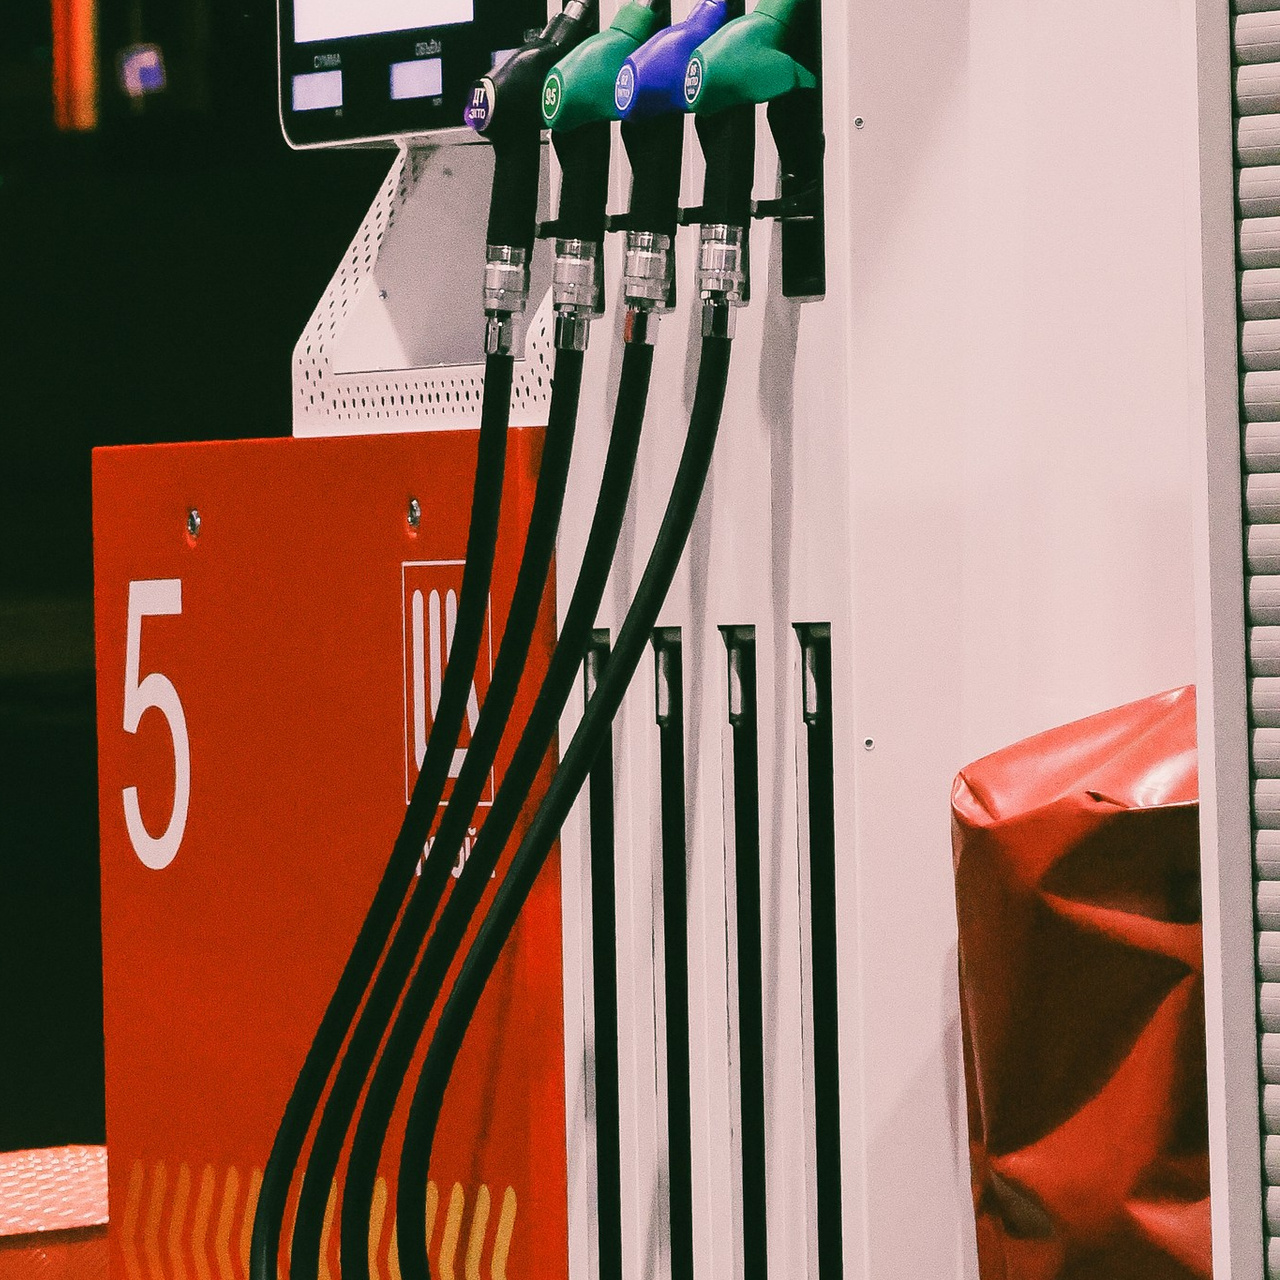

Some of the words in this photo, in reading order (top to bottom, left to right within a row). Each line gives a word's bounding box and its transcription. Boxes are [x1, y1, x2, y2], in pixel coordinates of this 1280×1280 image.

[472, 87, 486, 107] ДТ
[545, 87, 557, 106] 95
[122, 578, 191, 870] 5
